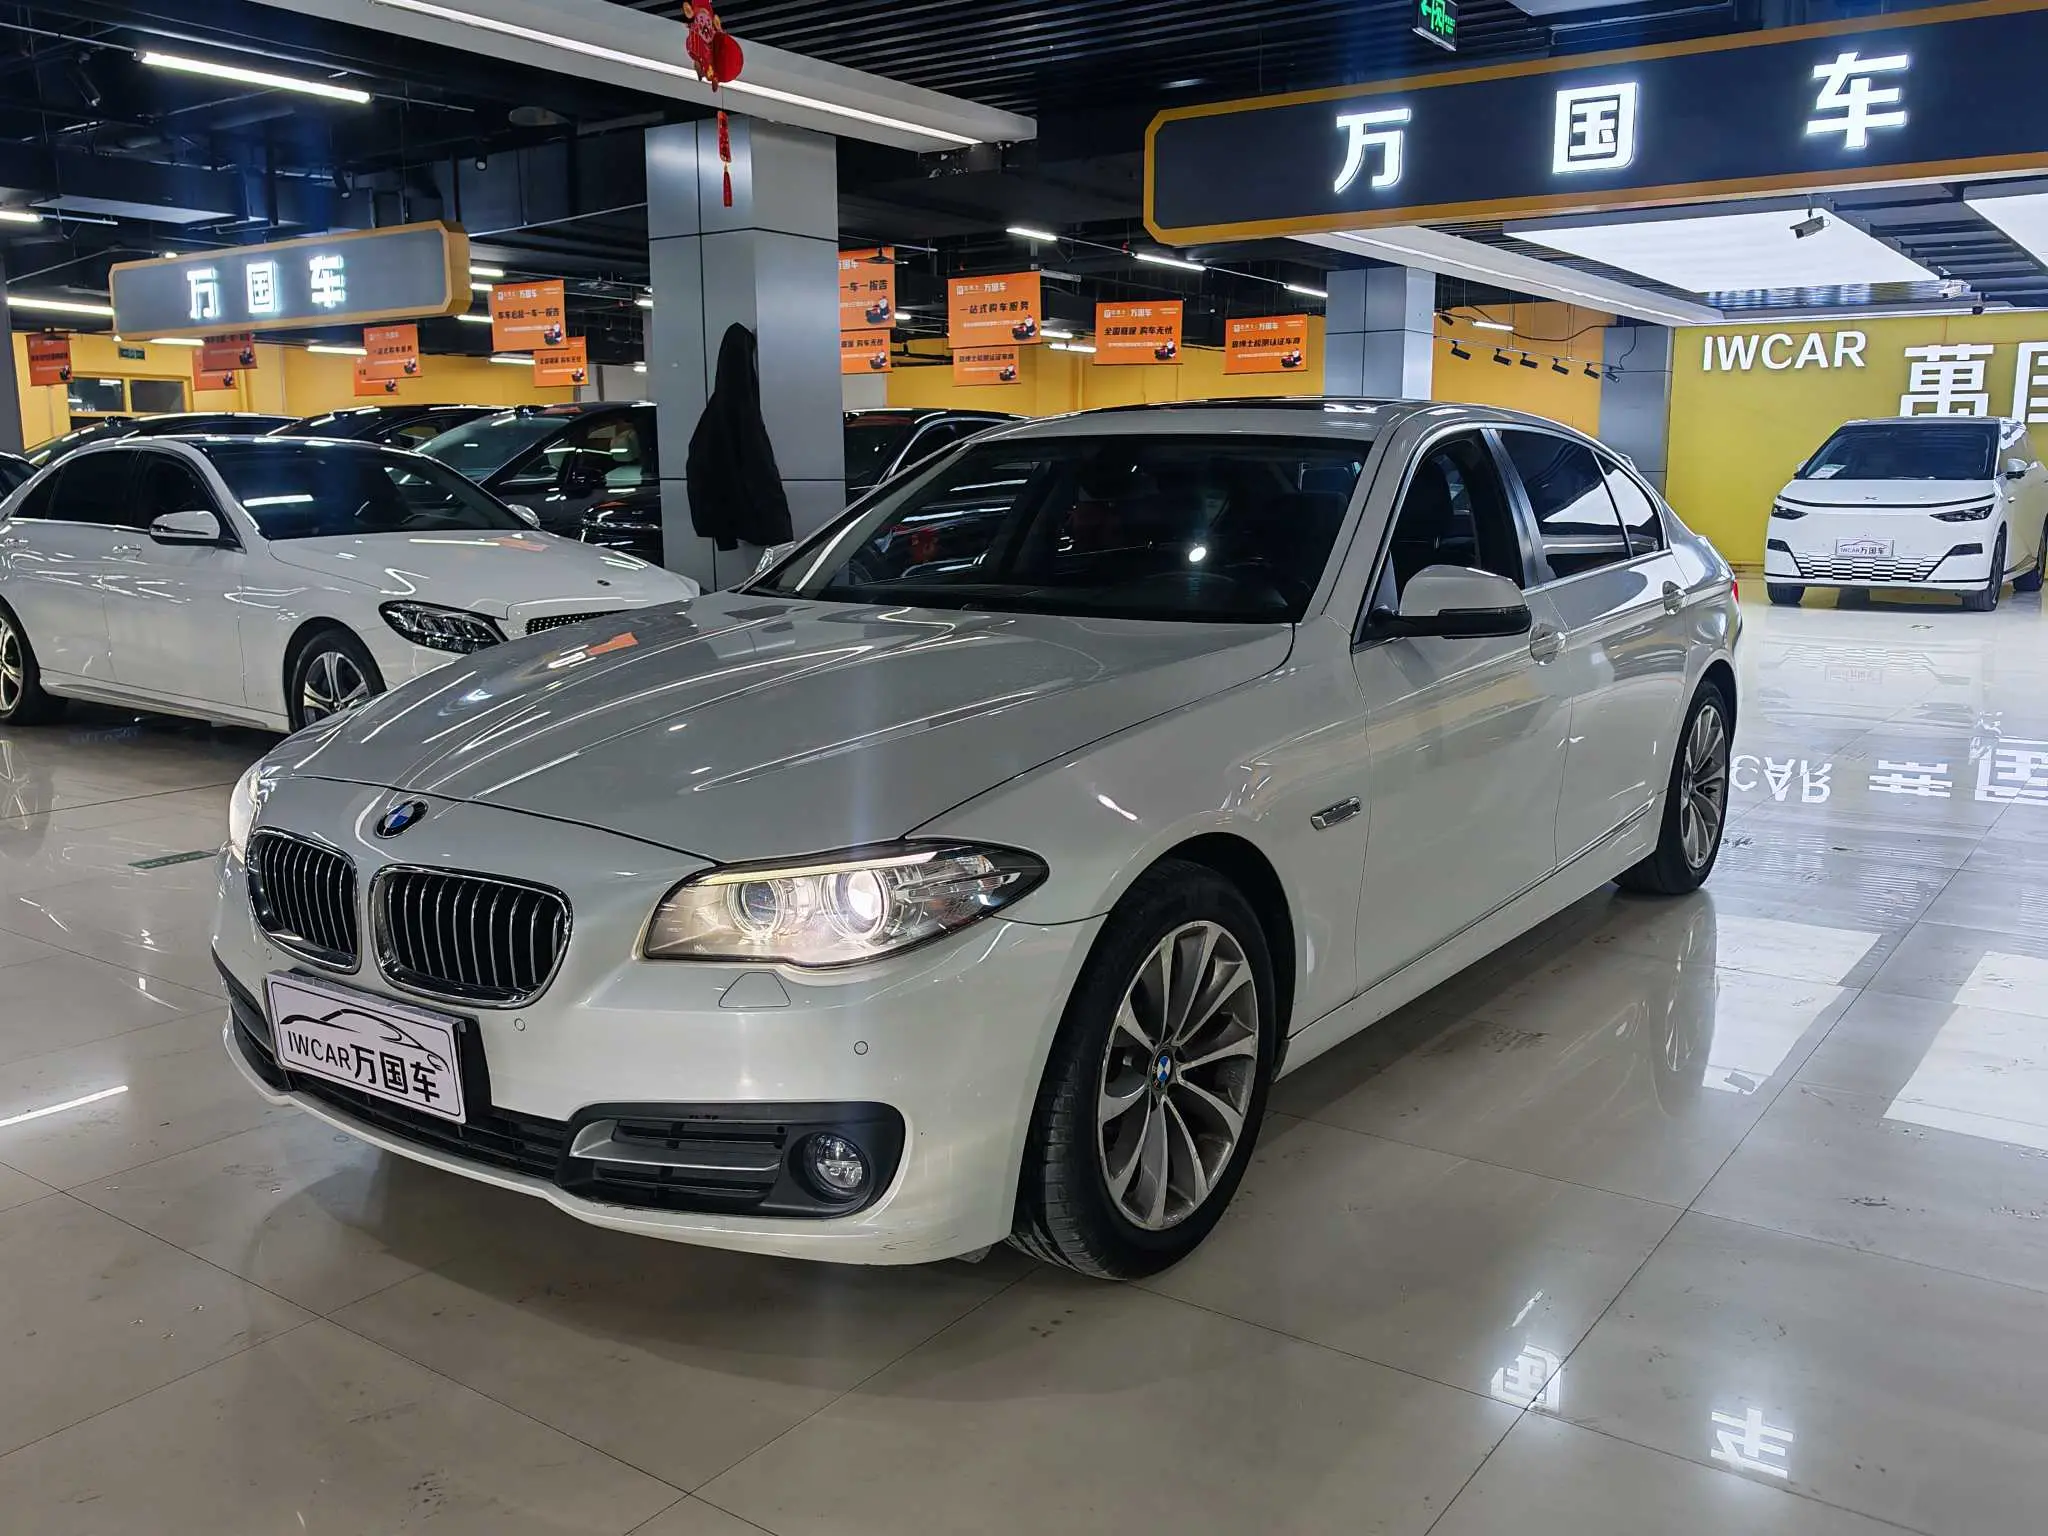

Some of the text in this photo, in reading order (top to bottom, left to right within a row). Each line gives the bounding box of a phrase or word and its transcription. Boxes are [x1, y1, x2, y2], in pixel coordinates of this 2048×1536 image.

[187, 255, 348, 320] 万国车
[960, 300, 1029, 314] 一站式购车服务
[1703, 331, 1867, 372] IWCAR
[287, 1030, 440, 1103] IWCAR万国车
